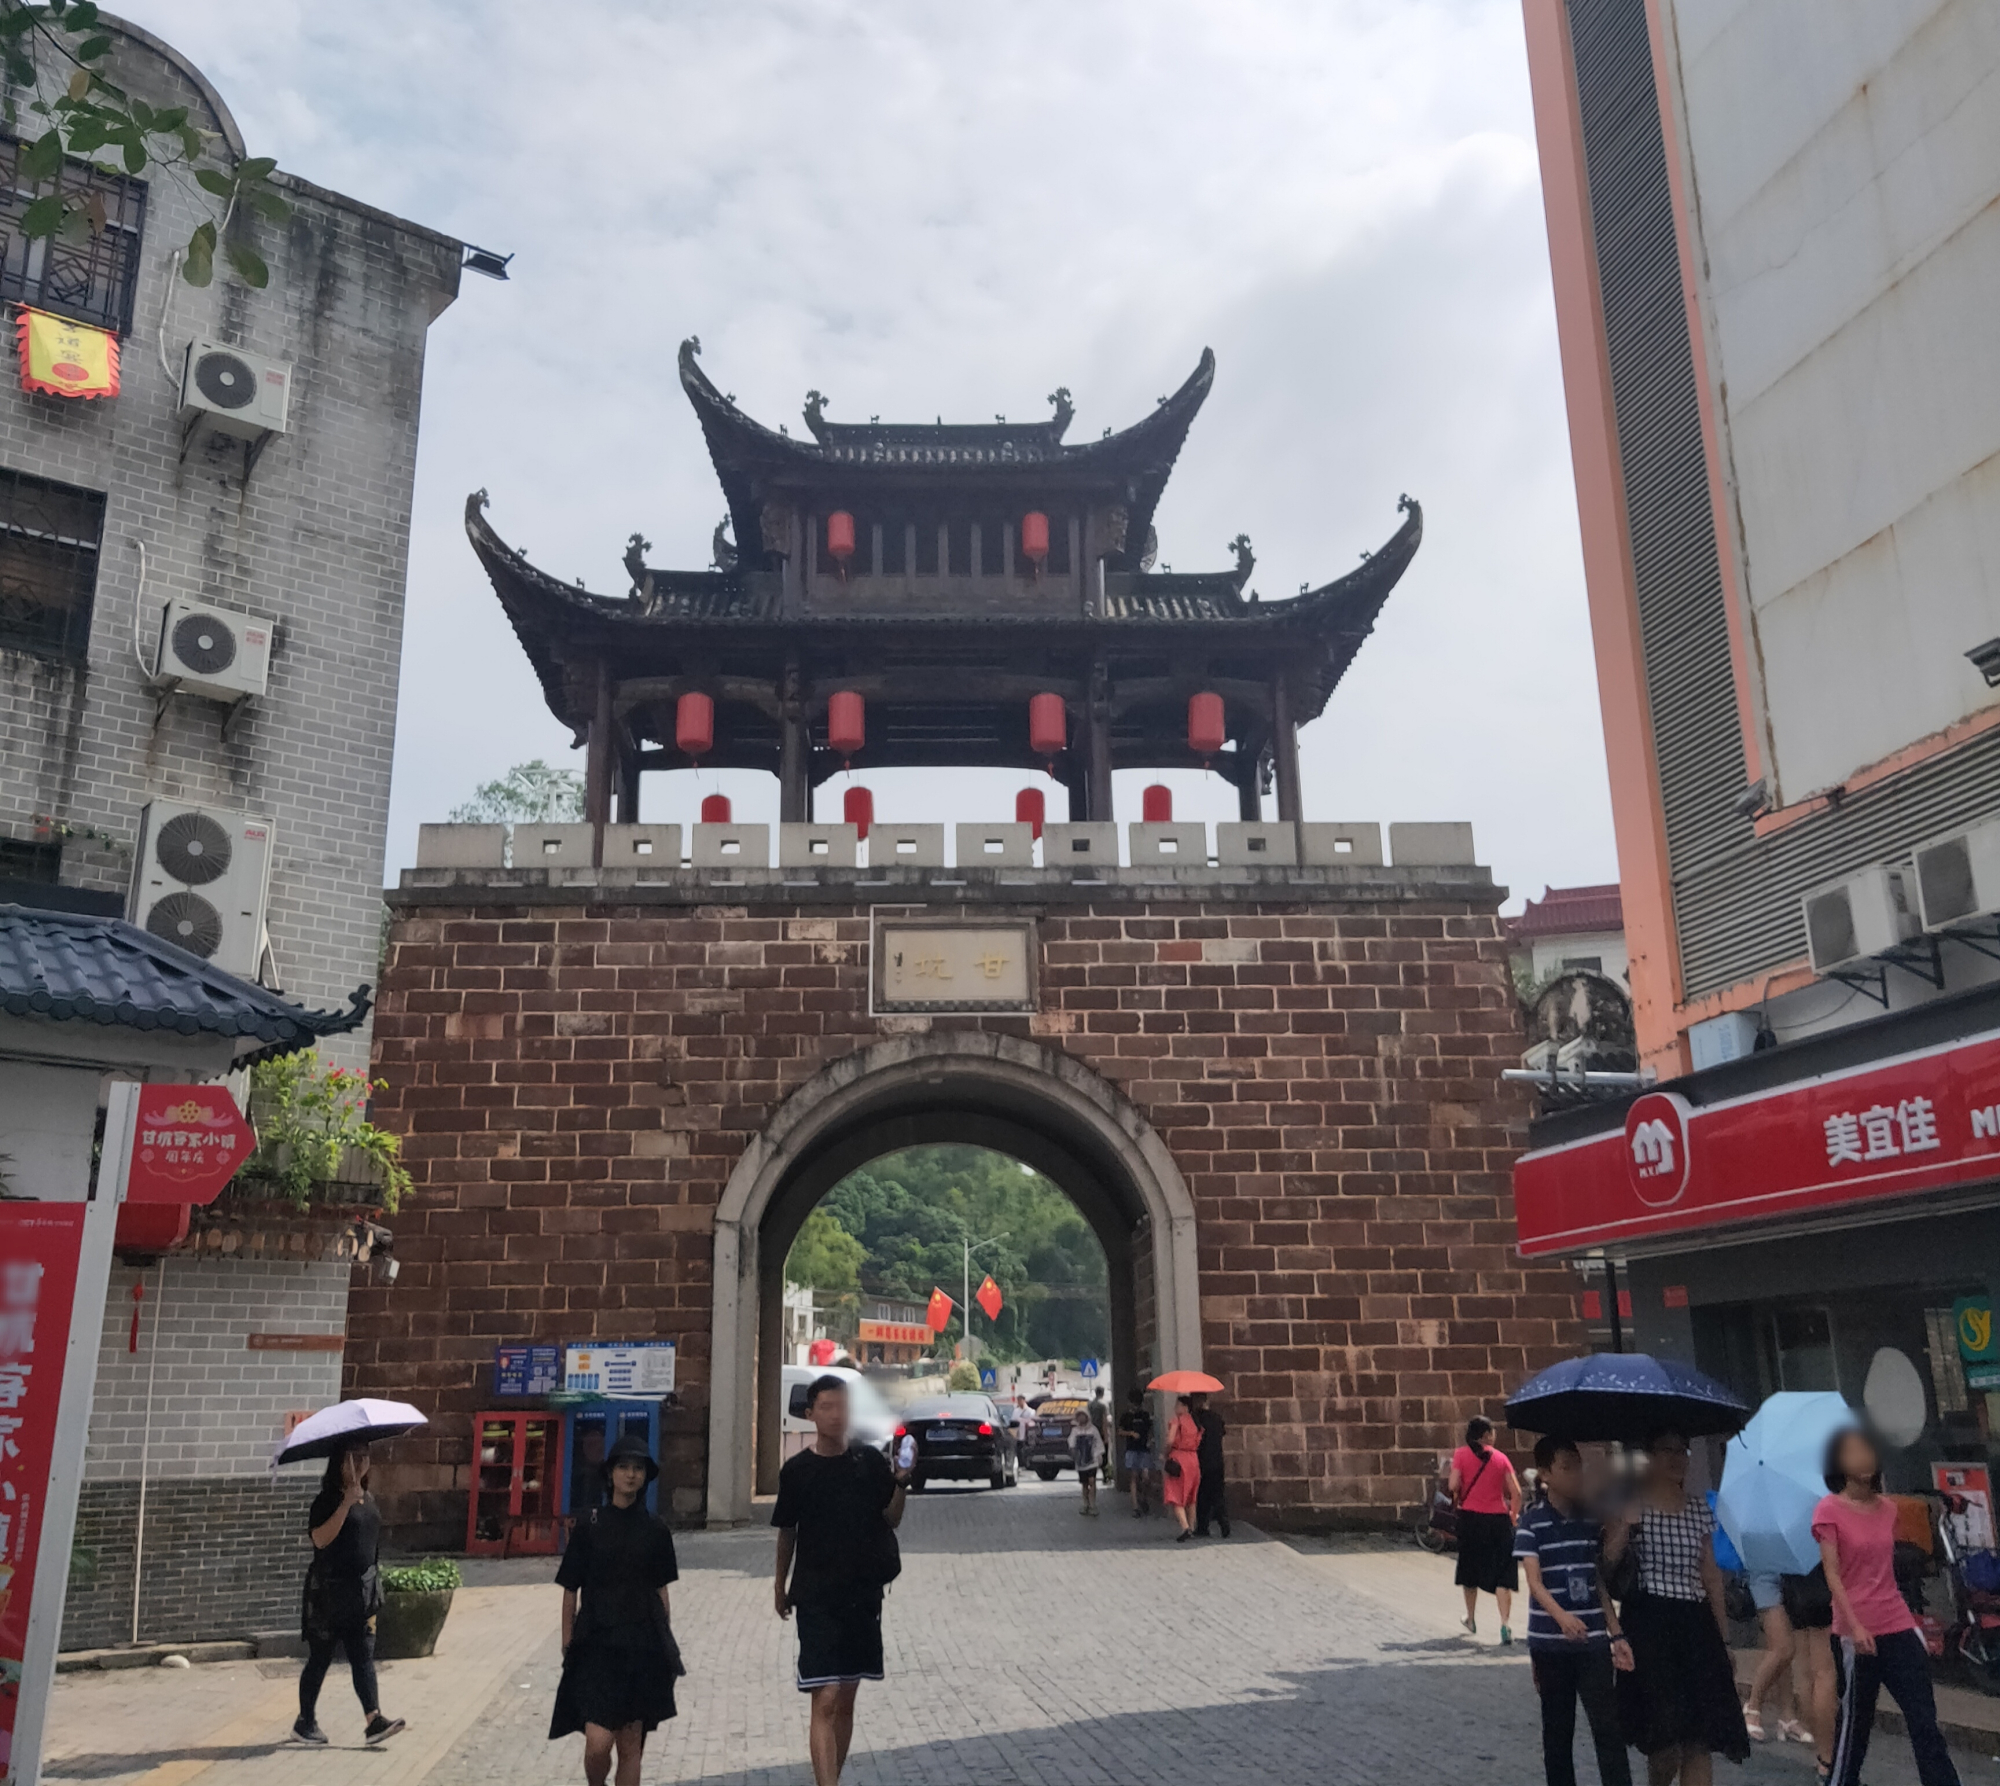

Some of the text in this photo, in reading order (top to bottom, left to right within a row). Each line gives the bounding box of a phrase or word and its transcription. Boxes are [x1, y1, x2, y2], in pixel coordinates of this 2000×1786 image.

[1823, 1096, 1940, 1168] 美宜佳
[1970, 1104, 2000, 1139] M
